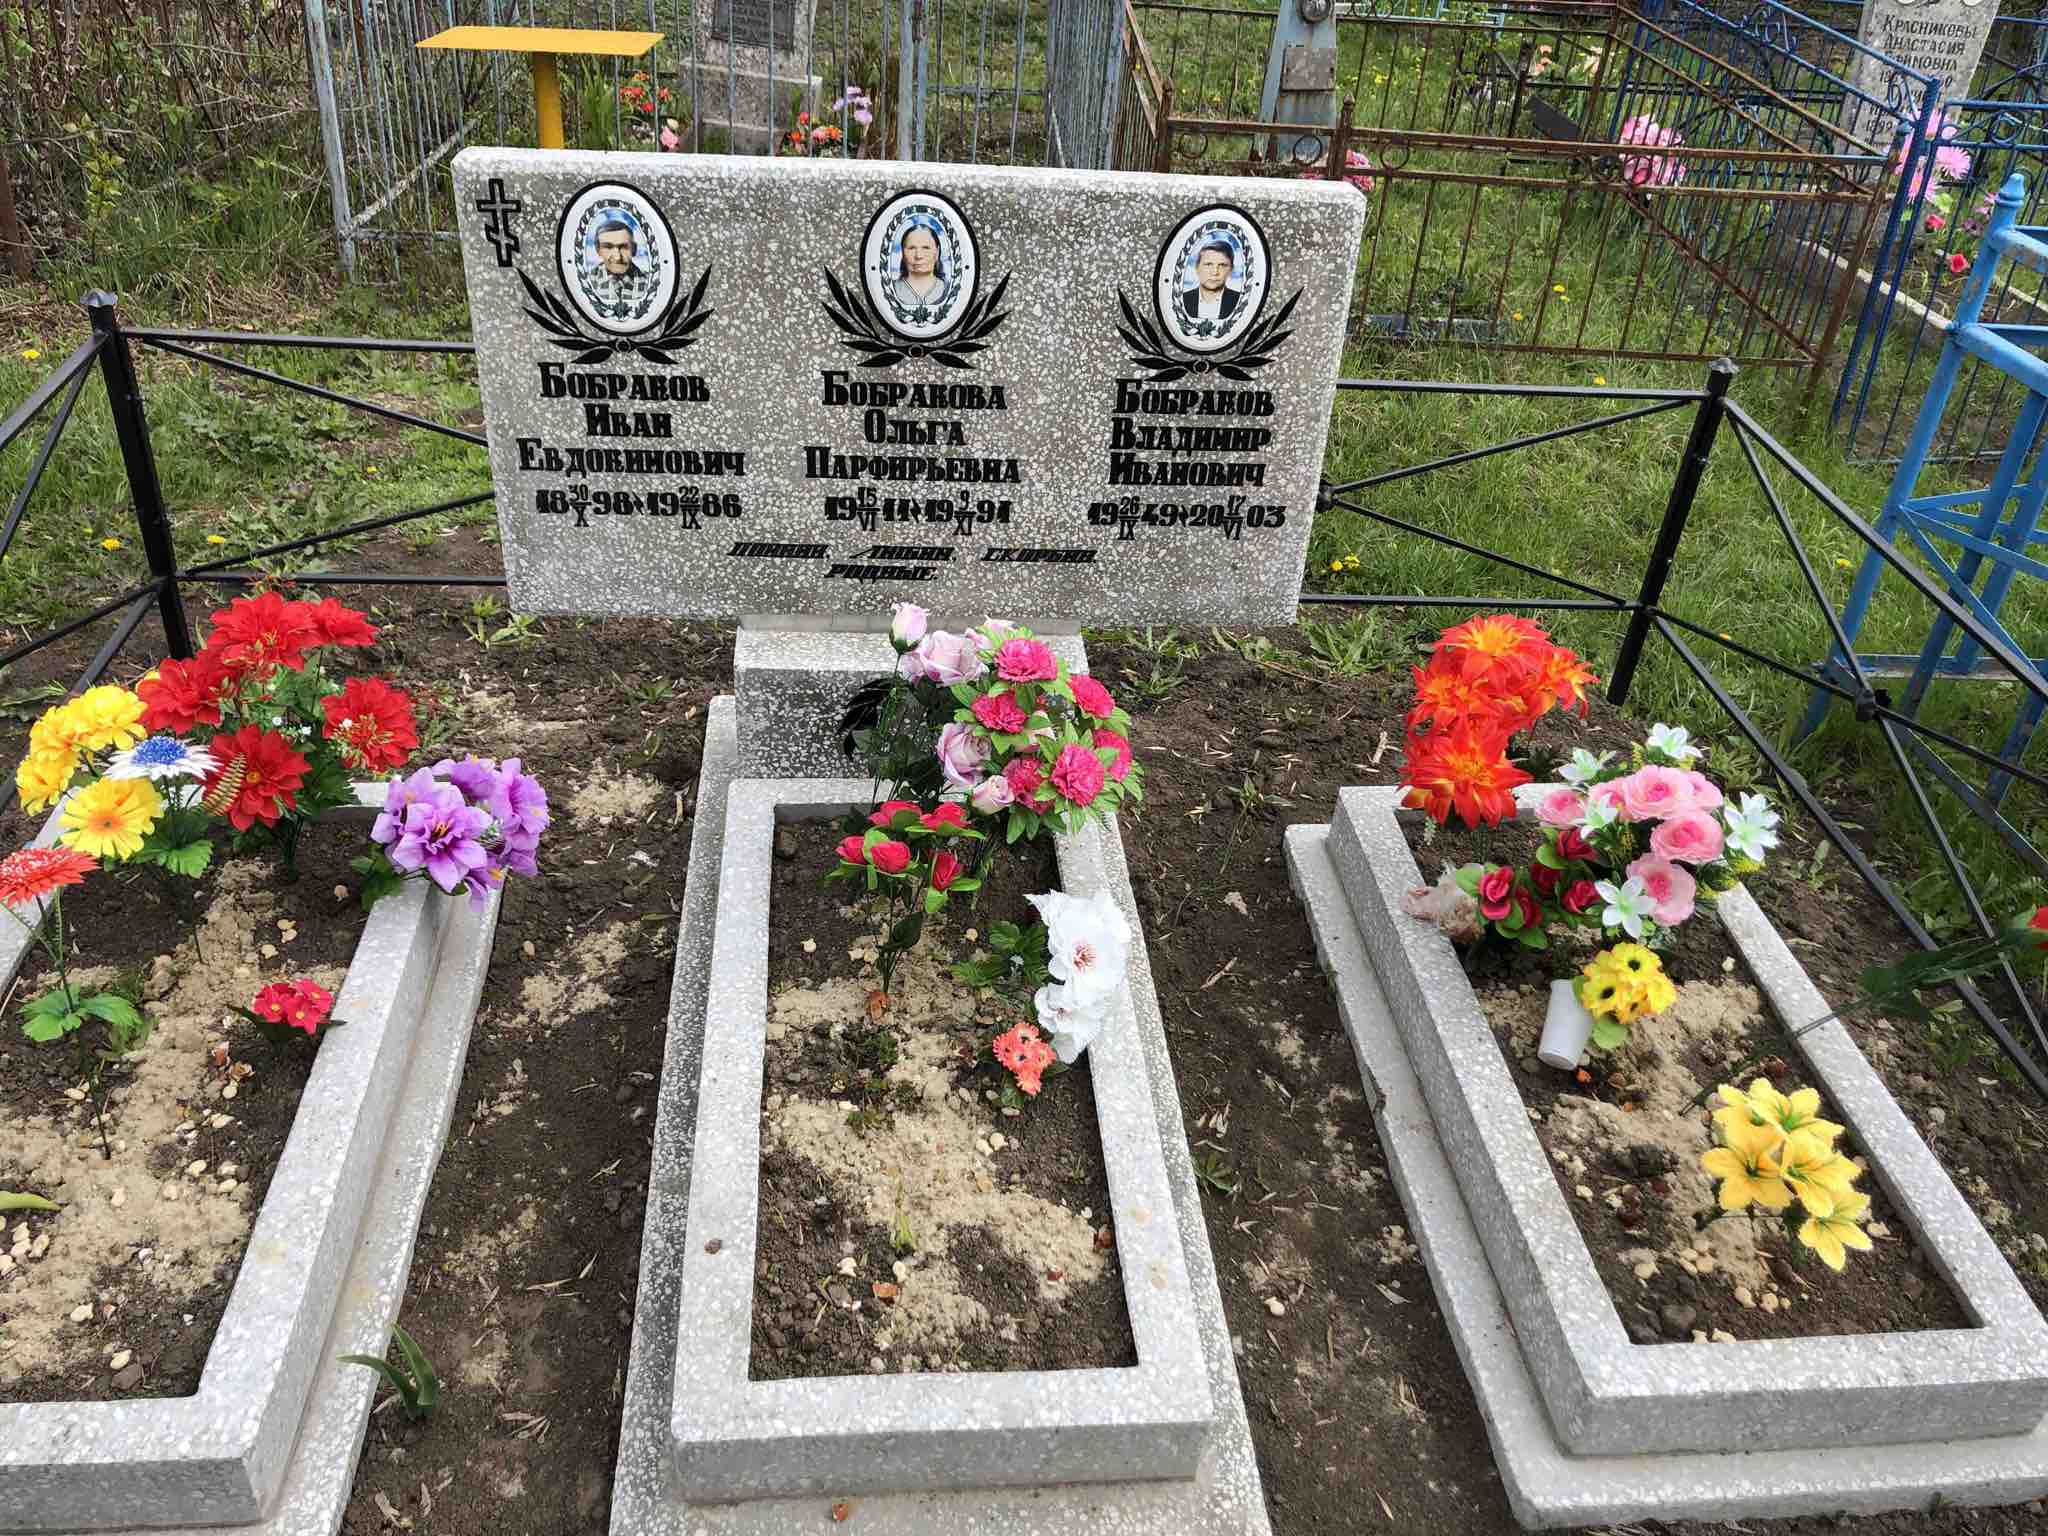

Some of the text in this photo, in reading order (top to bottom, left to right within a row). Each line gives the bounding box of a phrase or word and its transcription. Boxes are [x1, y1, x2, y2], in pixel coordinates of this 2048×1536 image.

[1884, 34, 1965, 56] АНАСТАСИЯ
[538, 362, 710, 401] БОБРАКОВ
[821, 370, 1007, 410] БОБРАКОВА
[1112, 379, 1275, 416] БОБРАКОВ
[584, 403, 673, 437] ИВАН
[864, 409, 966, 446] ОЛЬГА
[1109, 417, 1272, 457] ВЛАДИМИР
[516, 438, 746, 478] ЕВДОКИМОВИЧ
[804, 446, 1021, 483] ПАРФИРЬЕВНА
[1108, 452, 1266, 487] ИВАНОВИЧ
